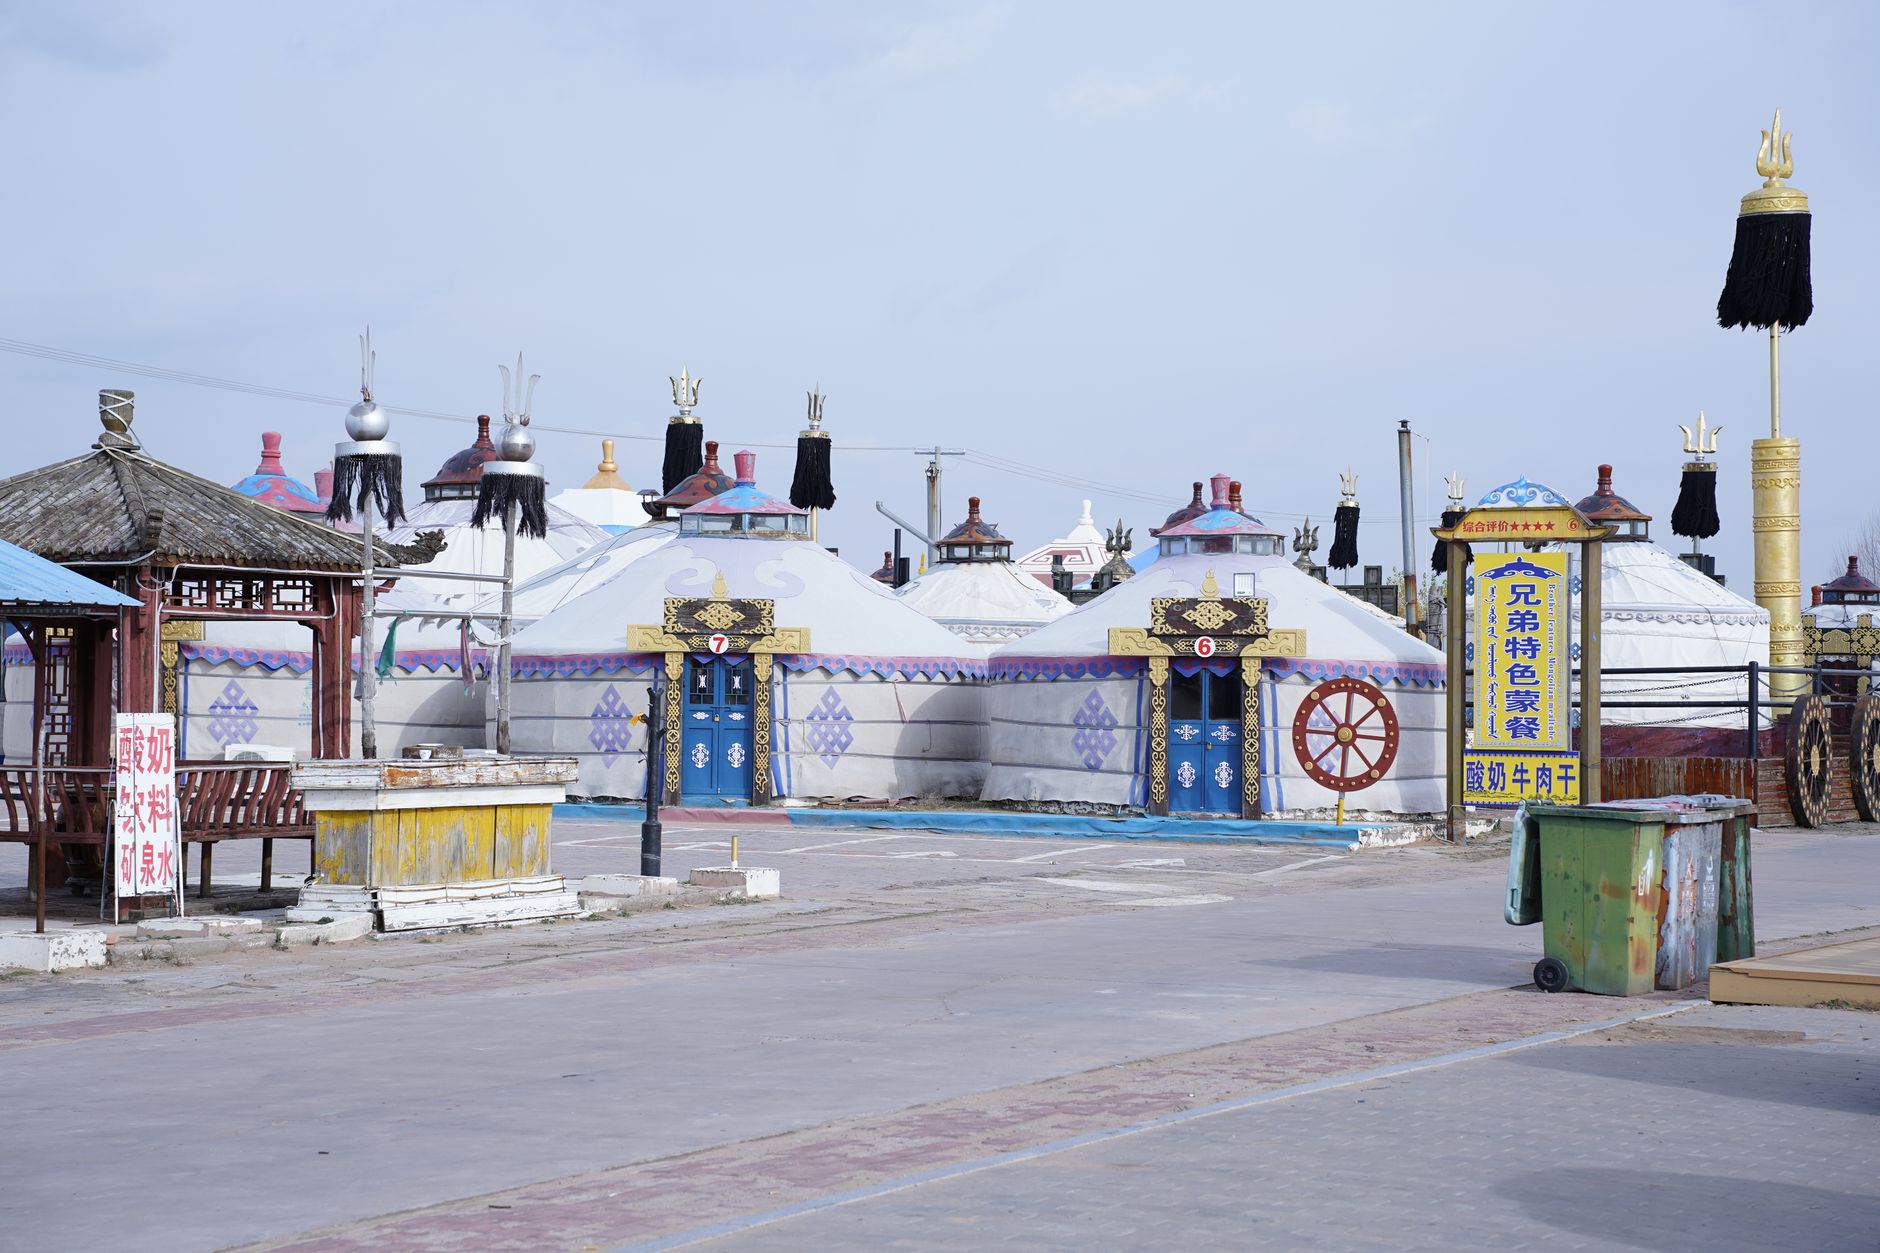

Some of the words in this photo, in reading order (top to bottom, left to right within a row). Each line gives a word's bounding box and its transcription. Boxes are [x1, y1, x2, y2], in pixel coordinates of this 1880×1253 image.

[1462, 520, 1509, 533] 综合评价
[1548, 584, 1556, 616] Brother
[712, 636, 725, 653] 7
[1198, 637, 1212, 656] 6
[1547, 619, 1556, 654] features
[1504, 583, 1542, 740] 兄弟特色蒙餐
[1547, 656, 1556, 700] Mongolian
[118, 725, 172, 775] 酸奶
[1465, 760, 1576, 795] 酸奶牛肉干
[120, 783, 173, 834] 饮料
[120, 840, 174, 887] 矿泉水
